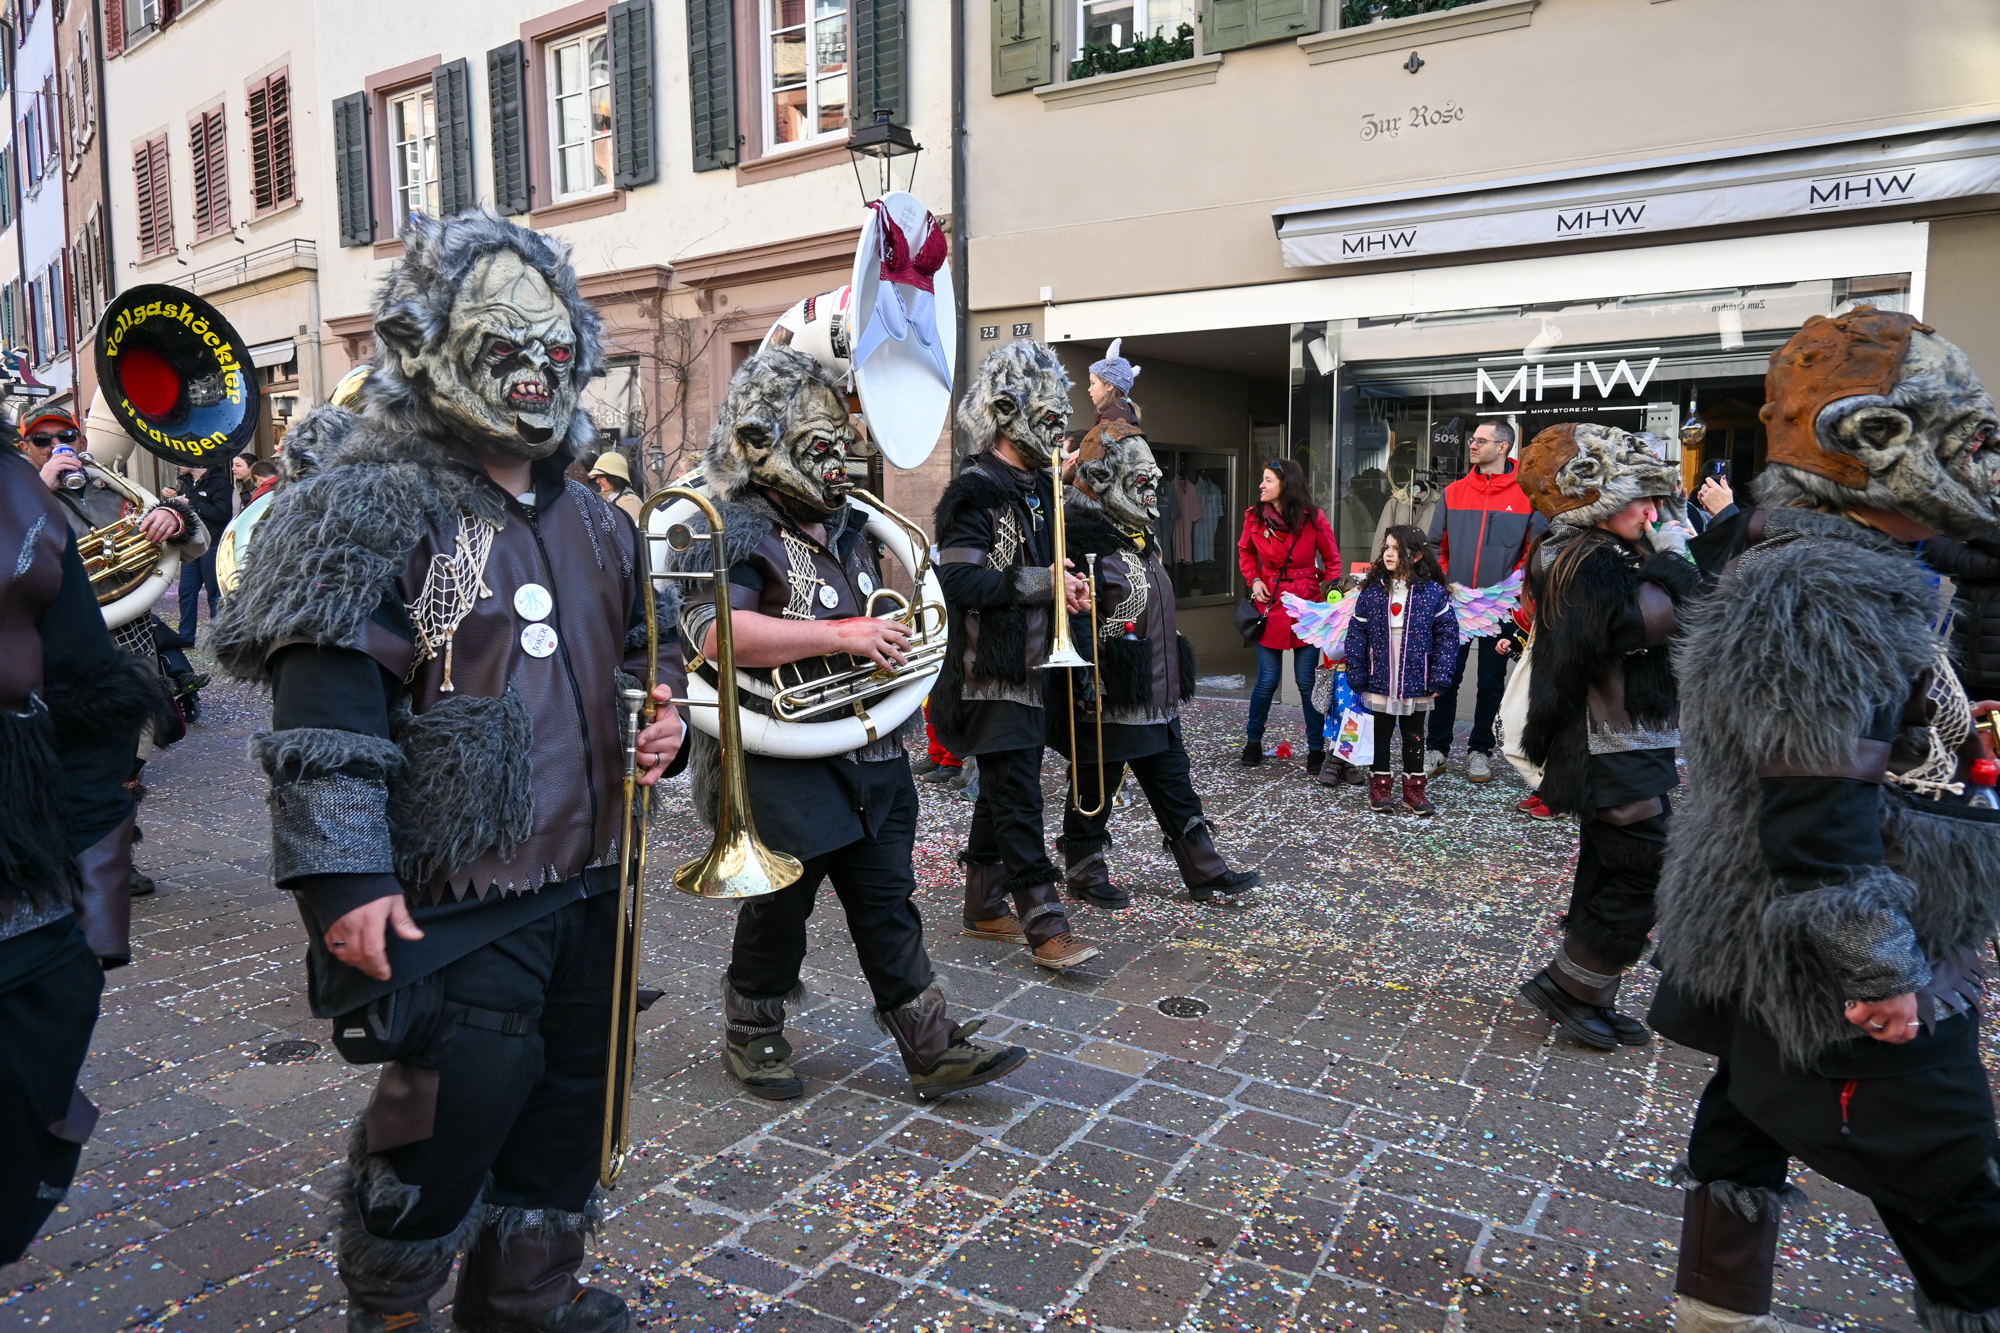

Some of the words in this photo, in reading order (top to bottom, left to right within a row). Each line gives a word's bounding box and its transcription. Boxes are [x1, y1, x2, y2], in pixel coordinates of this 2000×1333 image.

[1360, 113, 1401, 141] Zur
[1408, 100, 1464, 128] Rose
[1809, 173, 1915, 204] MHW
[1557, 205, 1646, 231] MHW
[1343, 230, 1417, 254] MHW
[983, 327, 995, 338] 25
[1015, 324, 1028, 336] 27
[107, 301, 241, 404] Vollgashöckler
[1475, 357, 1660, 404] MHW
[121, 399, 228, 456] Hedingen
[1434, 433, 1460, 444] 50%
[532, 627, 549, 654] JOKER
